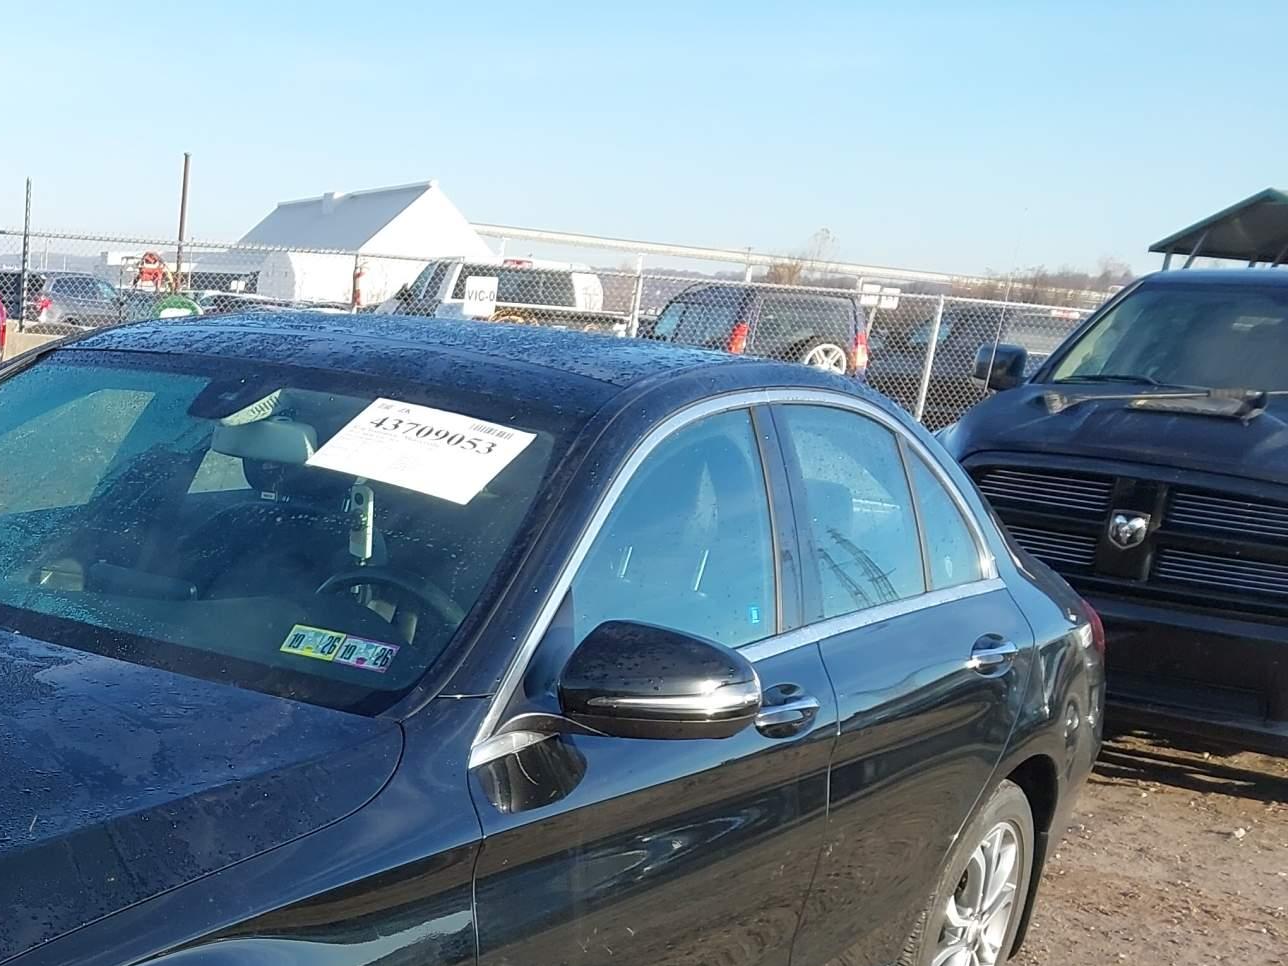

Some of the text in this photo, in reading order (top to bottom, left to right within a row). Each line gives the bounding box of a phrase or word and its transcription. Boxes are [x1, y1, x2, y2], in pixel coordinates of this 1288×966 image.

[369, 416, 497, 454] 43709053
[320, 635, 342, 654] 26
[373, 647, 394, 667] 26
